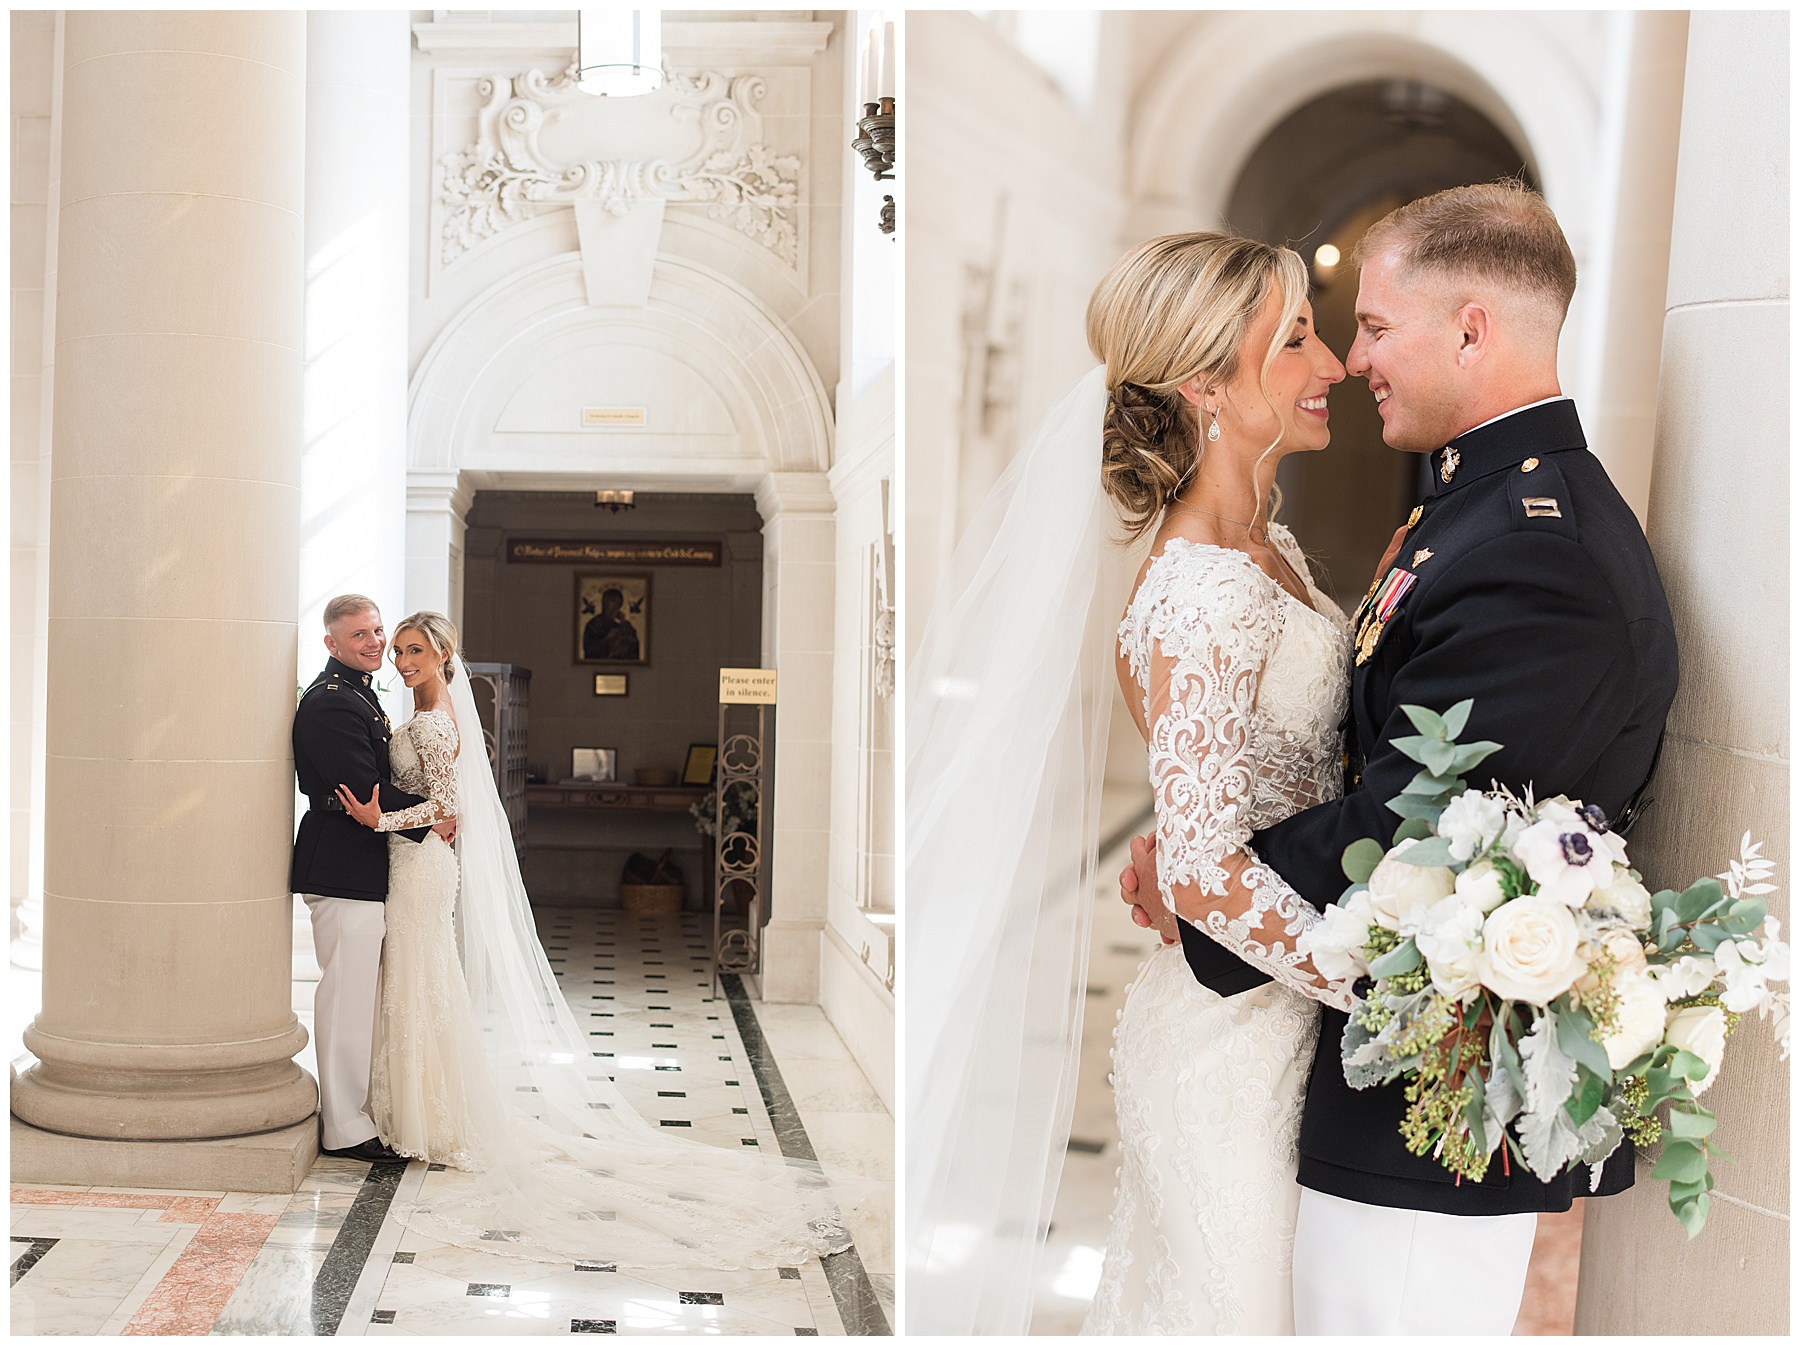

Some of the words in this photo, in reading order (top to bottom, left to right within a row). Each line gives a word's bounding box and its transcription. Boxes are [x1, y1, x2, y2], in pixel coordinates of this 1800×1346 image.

[722, 676, 749, 684] Please
[726, 688, 735, 696] in
[738, 688, 770, 697] silence.
